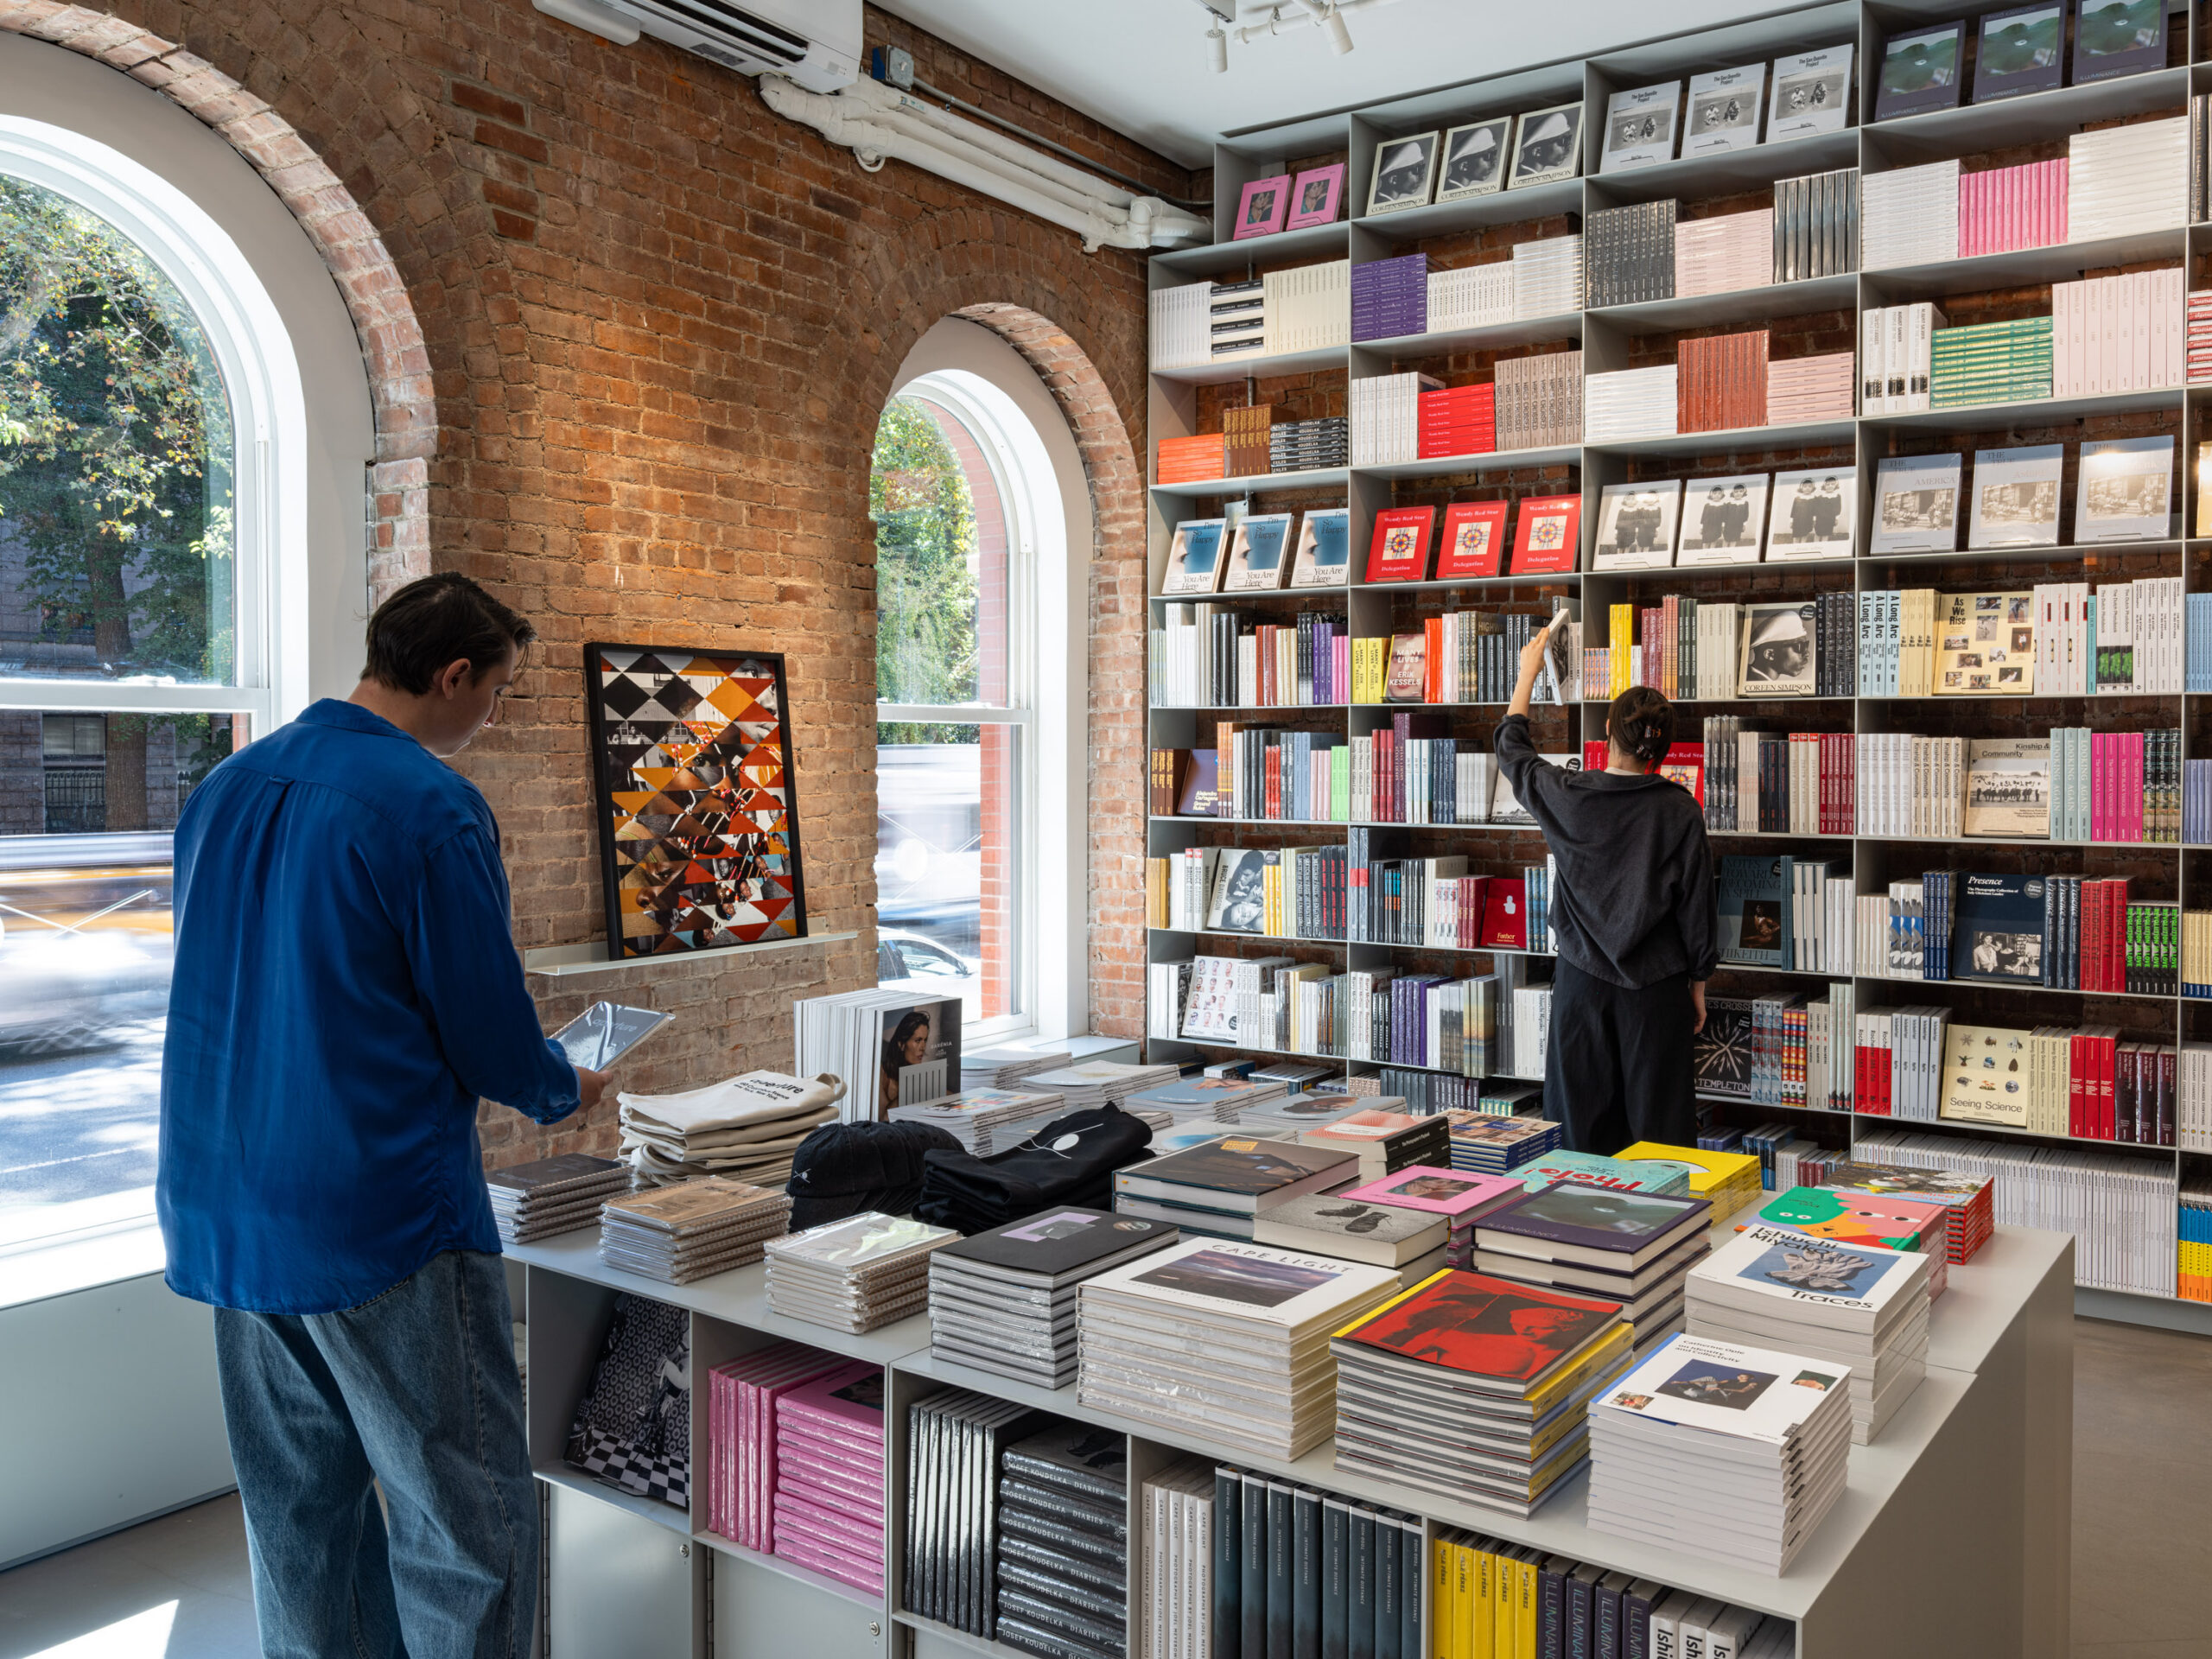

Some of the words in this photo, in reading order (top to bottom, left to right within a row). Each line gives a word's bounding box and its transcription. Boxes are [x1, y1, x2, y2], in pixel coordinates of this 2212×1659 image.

[2080, 70, 2120, 80] ILLUMINANCE
[1980, 88, 2018, 99] ILLUMINANCE
[1881, 107, 1917, 118] ILLUMINANCE
[1513, 176, 1541, 186] COREEN
[1441, 191, 1468, 200] COREEN
[1915, 476, 1955, 486] AMERICA
[1955, 597, 1963, 606] As
[1860, 604, 1871, 622] Long
[1874, 603, 1885, 622] Long
[1952, 607, 1965, 615] We
[1949, 616, 1966, 625] Rise
[1862, 625, 1871, 639] Arc
[1876, 624, 1885, 639] Arc
[1219, 865, 1229, 883] BRUCE
[1968, 876, 2003, 885] Presence
[1215, 881, 1225, 911] DAVIDSON
[2047, 883, 2056, 918] Presence
[1699, 1080, 1751, 1091] TEMPLETON
[772, 1090, 789, 1099] Avenue
[1950, 1097, 1981, 1109] Seeing
[1985, 1101, 2023, 1113] Science
[1487, 1223, 1560, 1237] ILLUMINANCE
[1750, 1232, 1830, 1254] Miyako
[1757, 1227, 1839, 1249] Ishiuchi
[1211, 1244, 1270, 1259] CAPE
[1279, 1256, 1354, 1274] LIGHT
[1790, 1289, 1873, 1309] Traces
[1683, 1340, 1723, 1351] Catherine
[1691, 1346, 1725, 1356] Identity
[1692, 1351, 1739, 1363] Collectivity
[1008, 1462, 1028, 1474] JOSEF
[1030, 1469, 1067, 1484] KOUDELKA
[1074, 1481, 1105, 1496] DIARIES
[1006, 1491, 1027, 1503] JOSEF
[1028, 1497, 1065, 1513] KOUDELKA
[1072, 1510, 1103, 1525] DIARIES
[1005, 1518, 1027, 1530] JOSEF
[1027, 1526, 1065, 1542] KOUDELKA
[1072, 1539, 1103, 1554] DIARIES
[1005, 1602, 1025, 1615] JOSEF
[1026, 1611, 1063, 1627] KOUDELKA
[1071, 1625, 1100, 1641] DIARIES
